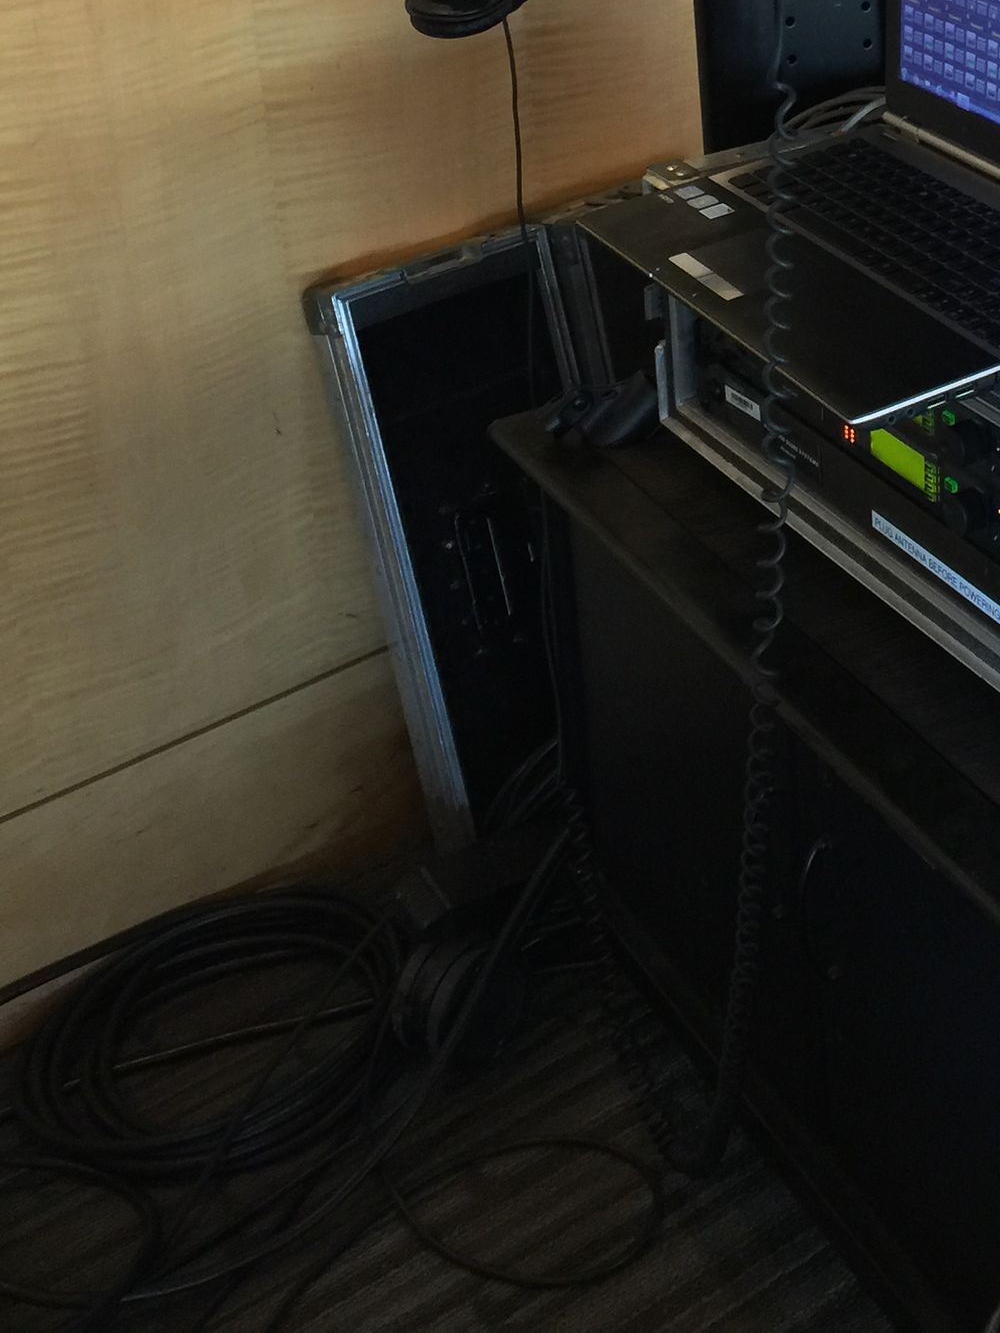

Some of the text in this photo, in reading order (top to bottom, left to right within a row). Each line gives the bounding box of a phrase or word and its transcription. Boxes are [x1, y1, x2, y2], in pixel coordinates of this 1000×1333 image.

[874, 517, 893, 538] PLUG
[894, 533, 927, 564] ANTENNA
[928, 558, 959, 589] BEFORE
[959, 581, 1000, 620] POWERING
